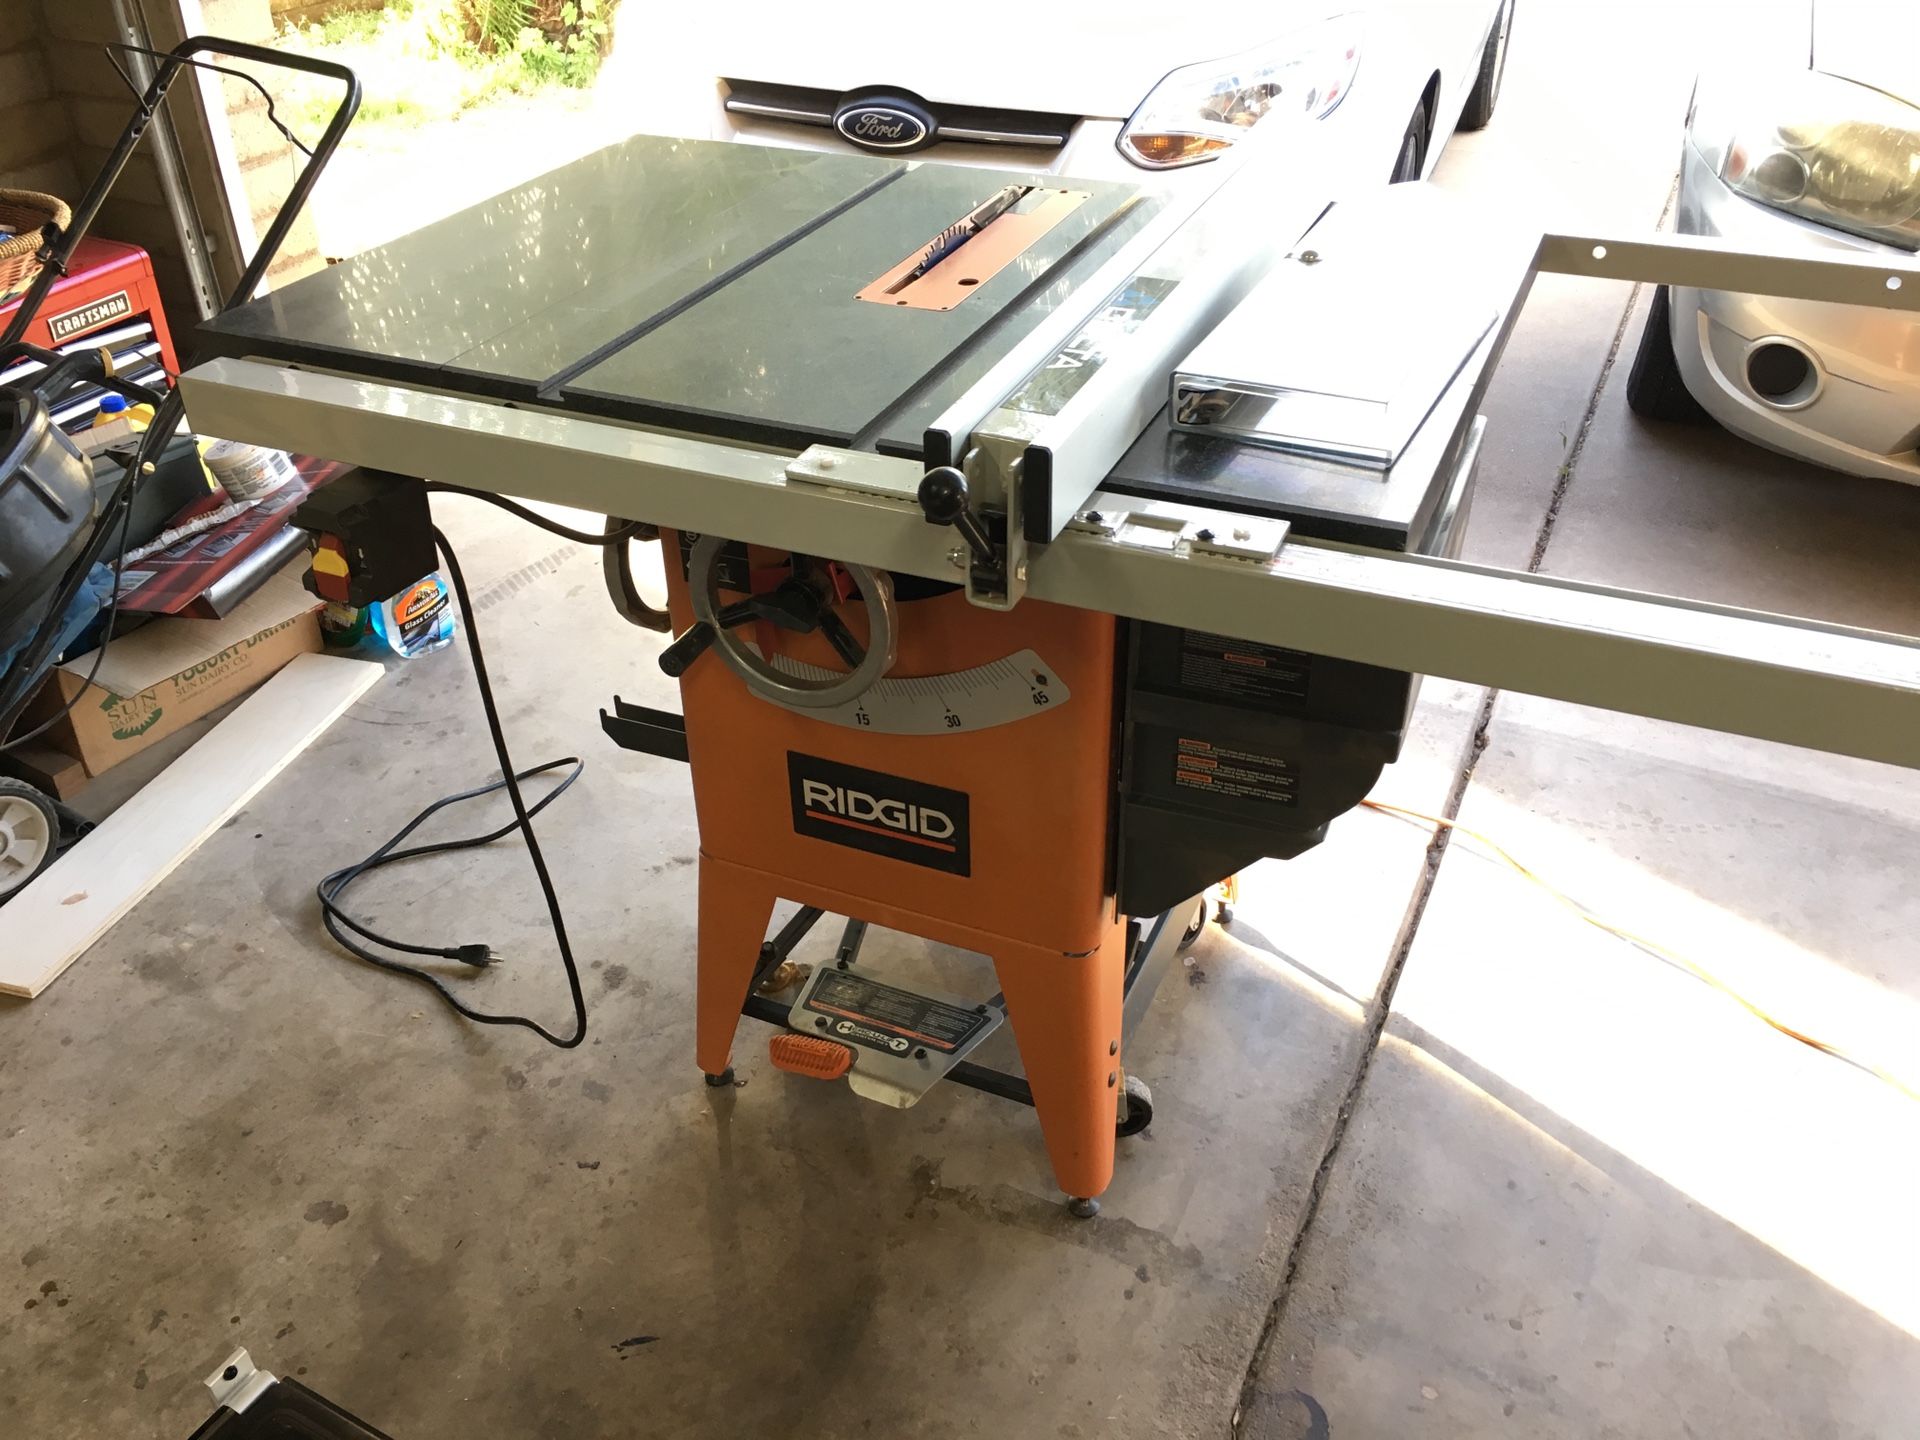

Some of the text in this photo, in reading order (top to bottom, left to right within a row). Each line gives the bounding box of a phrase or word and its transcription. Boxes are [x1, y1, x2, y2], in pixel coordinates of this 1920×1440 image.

[854, 113, 904, 139] Ford
[56, 297, 127, 335] CRAFTSMAN
[404, 614, 424, 631] Glass
[423, 598, 446, 622] Cleaner
[176, 679, 198, 697] SUN
[199, 662, 231, 685] DAIRY
[107, 688, 157, 721] SUN
[1032, 690, 1050, 706] 45
[109, 712, 140, 731] DAIRY
[856, 712, 870, 726] 15
[945, 714, 961, 728] 30
[802, 778, 956, 840] RIDGID
